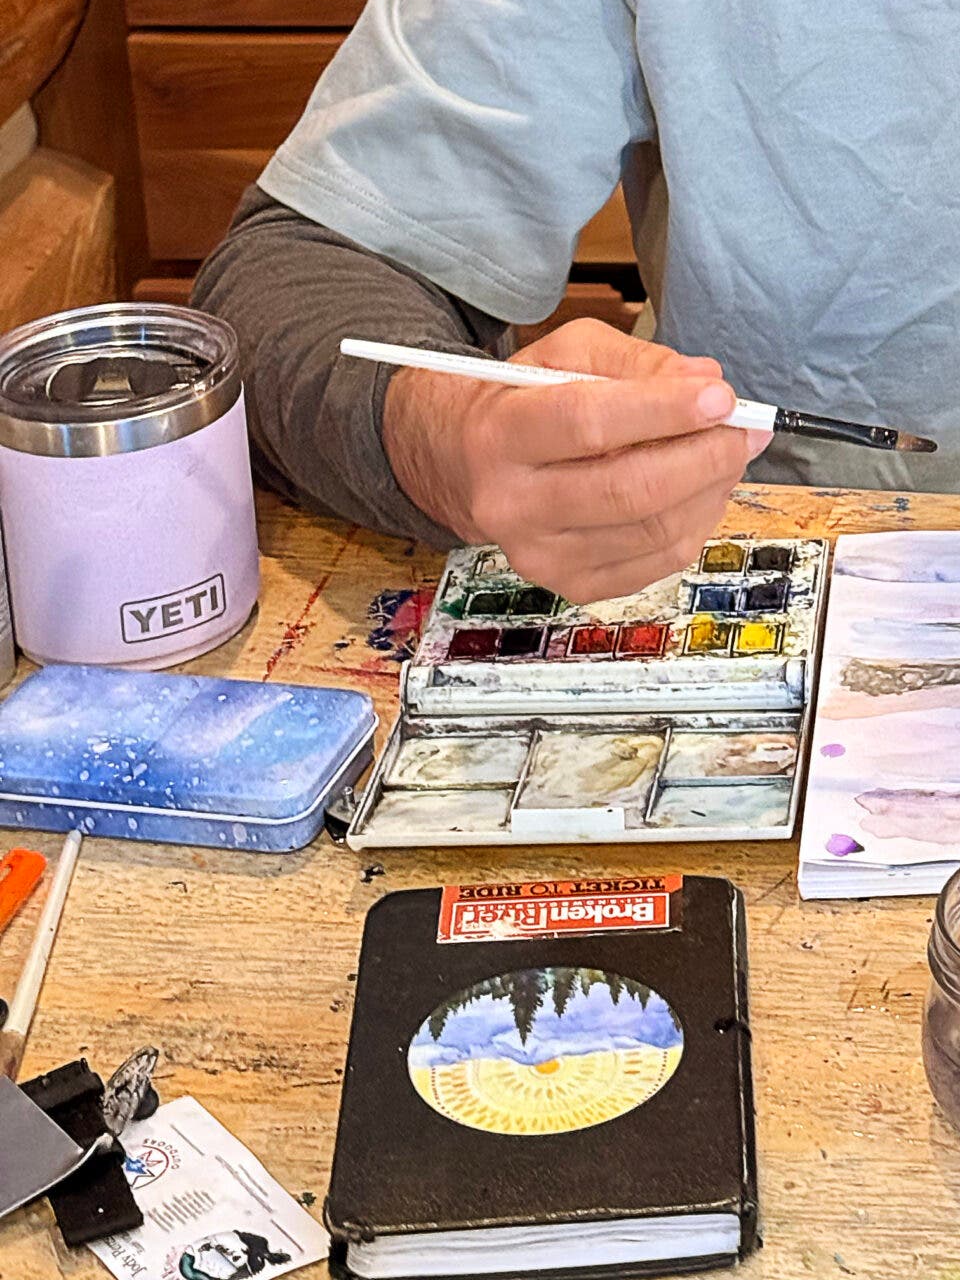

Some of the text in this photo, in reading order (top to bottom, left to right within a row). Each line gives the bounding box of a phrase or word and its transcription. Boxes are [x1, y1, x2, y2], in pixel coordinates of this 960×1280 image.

[128, 586, 222, 634] YETI
[459, 878, 665, 899] TICKET TO RIDE
[550, 903, 654, 924] Broken
